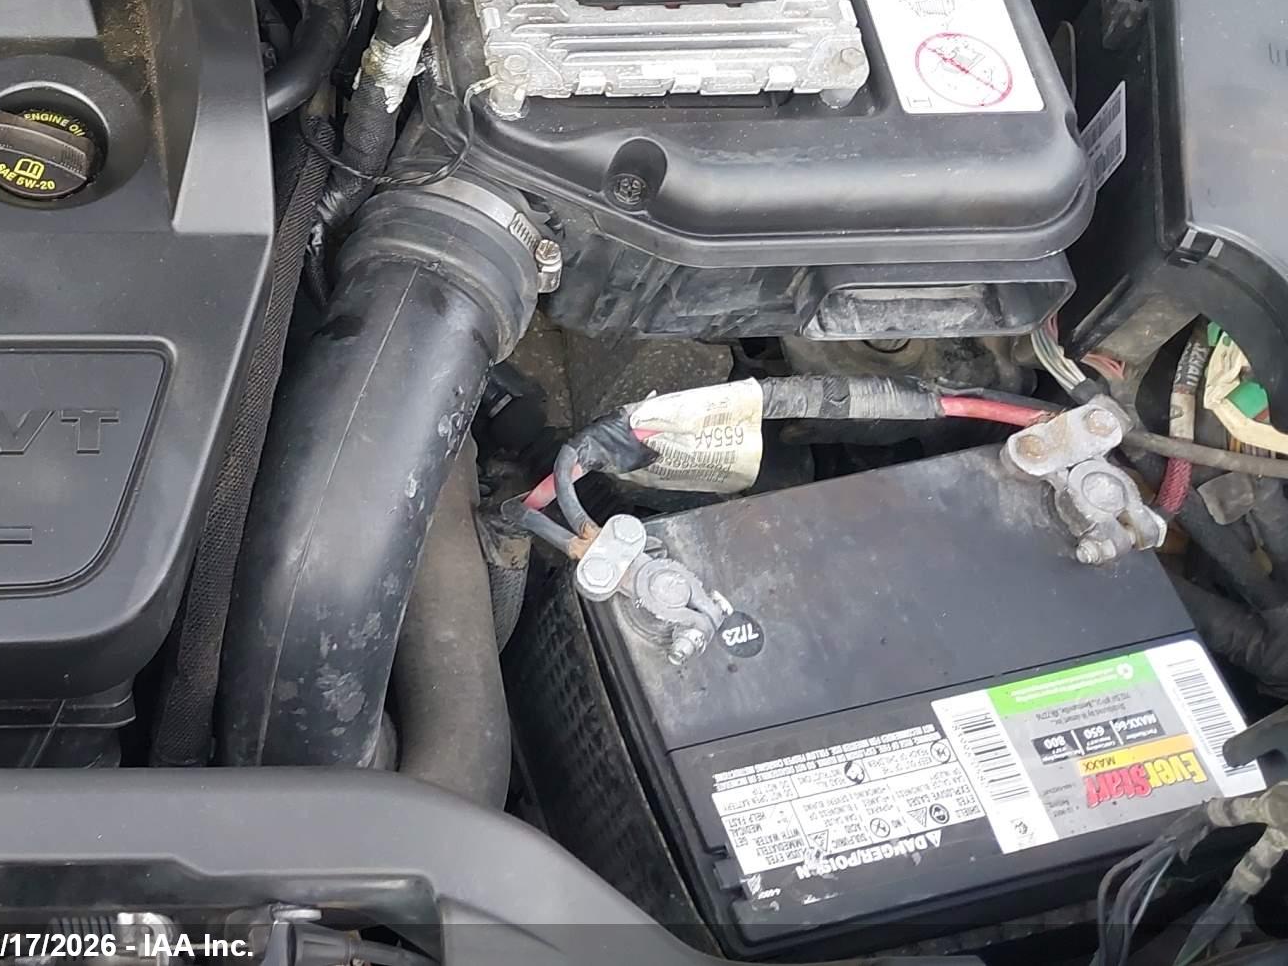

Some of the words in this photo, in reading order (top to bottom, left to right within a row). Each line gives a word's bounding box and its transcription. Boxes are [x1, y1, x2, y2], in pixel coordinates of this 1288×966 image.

[15, 176, 56, 189] 5W-20
[1082, 724, 1106, 740] 650
[1041, 734, 1066, 749] 800
[1081, 755, 1116, 772] MAXX
[1079, 749, 1210, 809] EverStart
